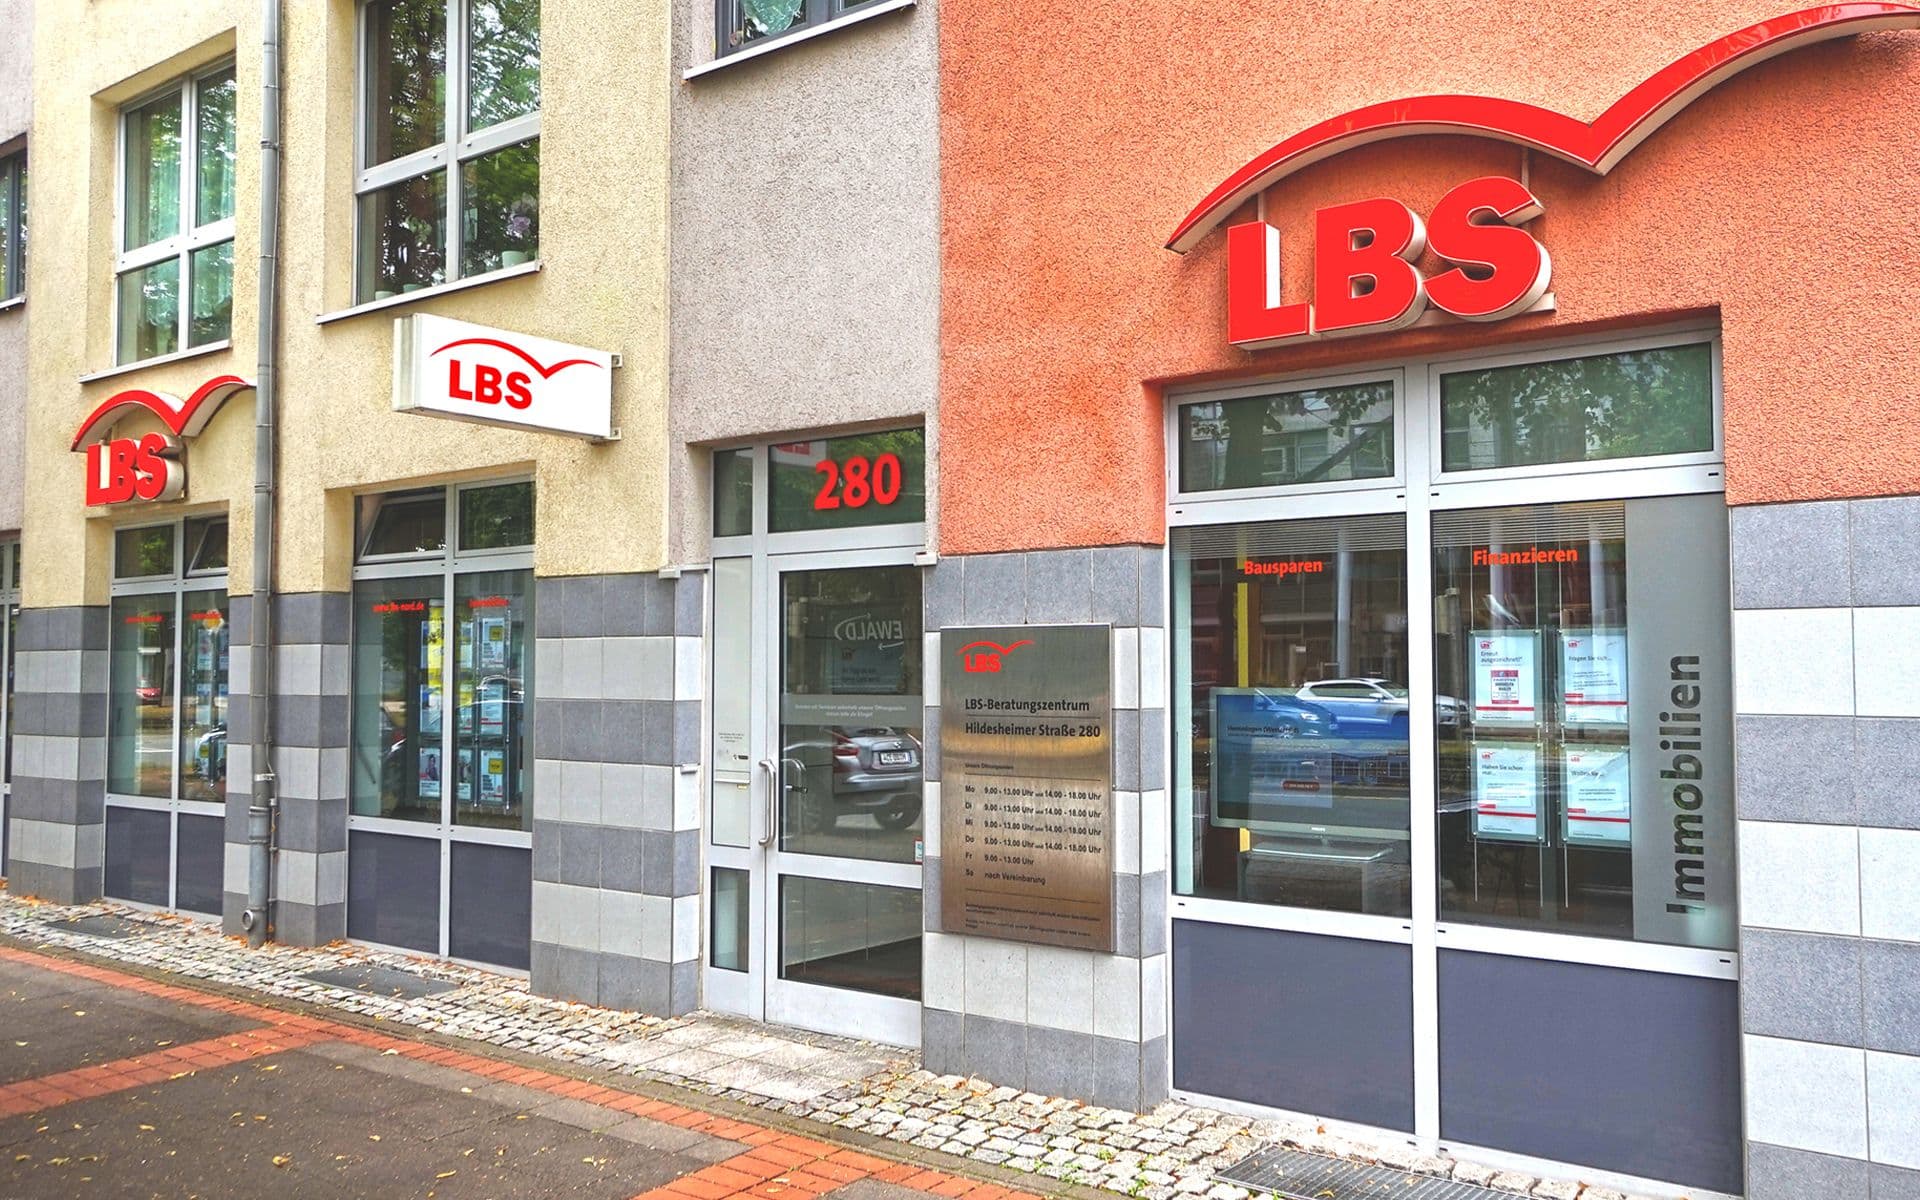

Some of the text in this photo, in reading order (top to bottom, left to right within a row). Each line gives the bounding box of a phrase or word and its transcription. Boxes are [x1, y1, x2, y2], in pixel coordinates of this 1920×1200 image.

[1228, 176, 1552, 351] LBS
[449, 359, 533, 410] LBS
[86, 432, 183, 506] LBS
[814, 453, 902, 510] 280
[1473, 546, 1578, 566] Finanzieren
[1244, 560, 1322, 579] Bausparen
[964, 653, 1002, 673] LBS
[965, 698, 1090, 713] LBS-Beratungszentrum
[965, 723, 1101, 737] Hildesheimer Straße 280
[965, 785, 975, 793] Mo
[1088, 792, 1101, 800] Uhr
[1659, 655, 1706, 914] Immobilien
[1022, 806, 1034, 814] Uhr
[1088, 809, 1101, 817] Uhr
[1088, 826, 1101, 835] Uhr
[965, 835, 975, 843] Do
[984, 837, 998, 845] 9.00
[1088, 844, 1101, 852] Uhr
[984, 854, 998, 862] 9.00
[1022, 857, 1034, 865] Uhr
[1002, 872, 1046, 885] Vereinbarung
